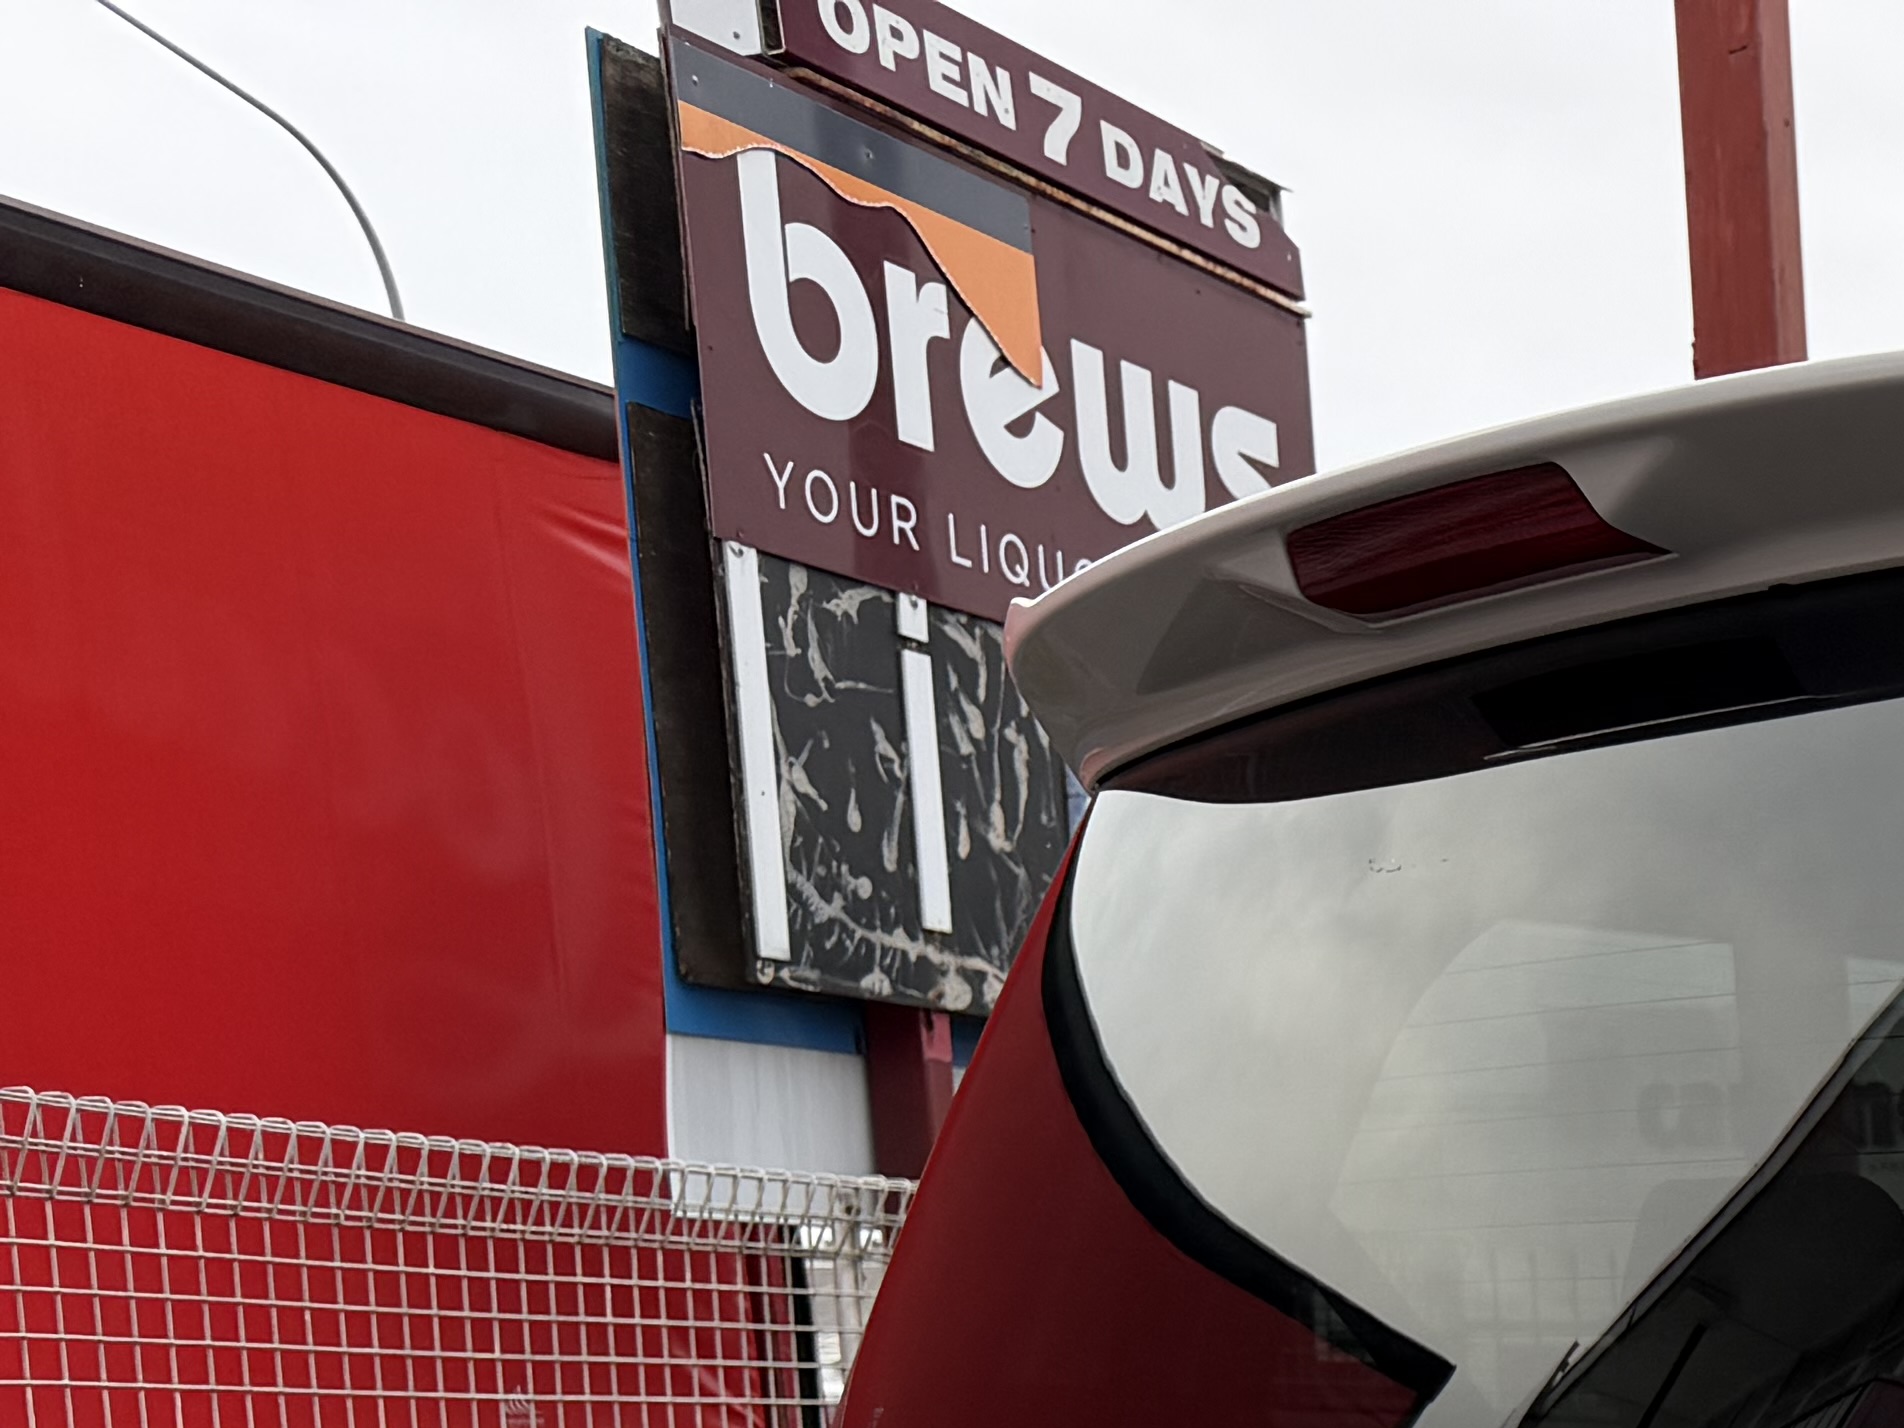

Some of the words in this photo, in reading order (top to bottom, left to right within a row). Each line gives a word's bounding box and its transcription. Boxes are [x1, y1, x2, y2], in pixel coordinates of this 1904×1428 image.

[817, 0, 1017, 131] OPEN
[1028, 71, 1082, 166] 7
[1099, 118, 1262, 250] DAYS
[736, 149, 1280, 531] brews
[763, 451, 920, 552] YOUR
